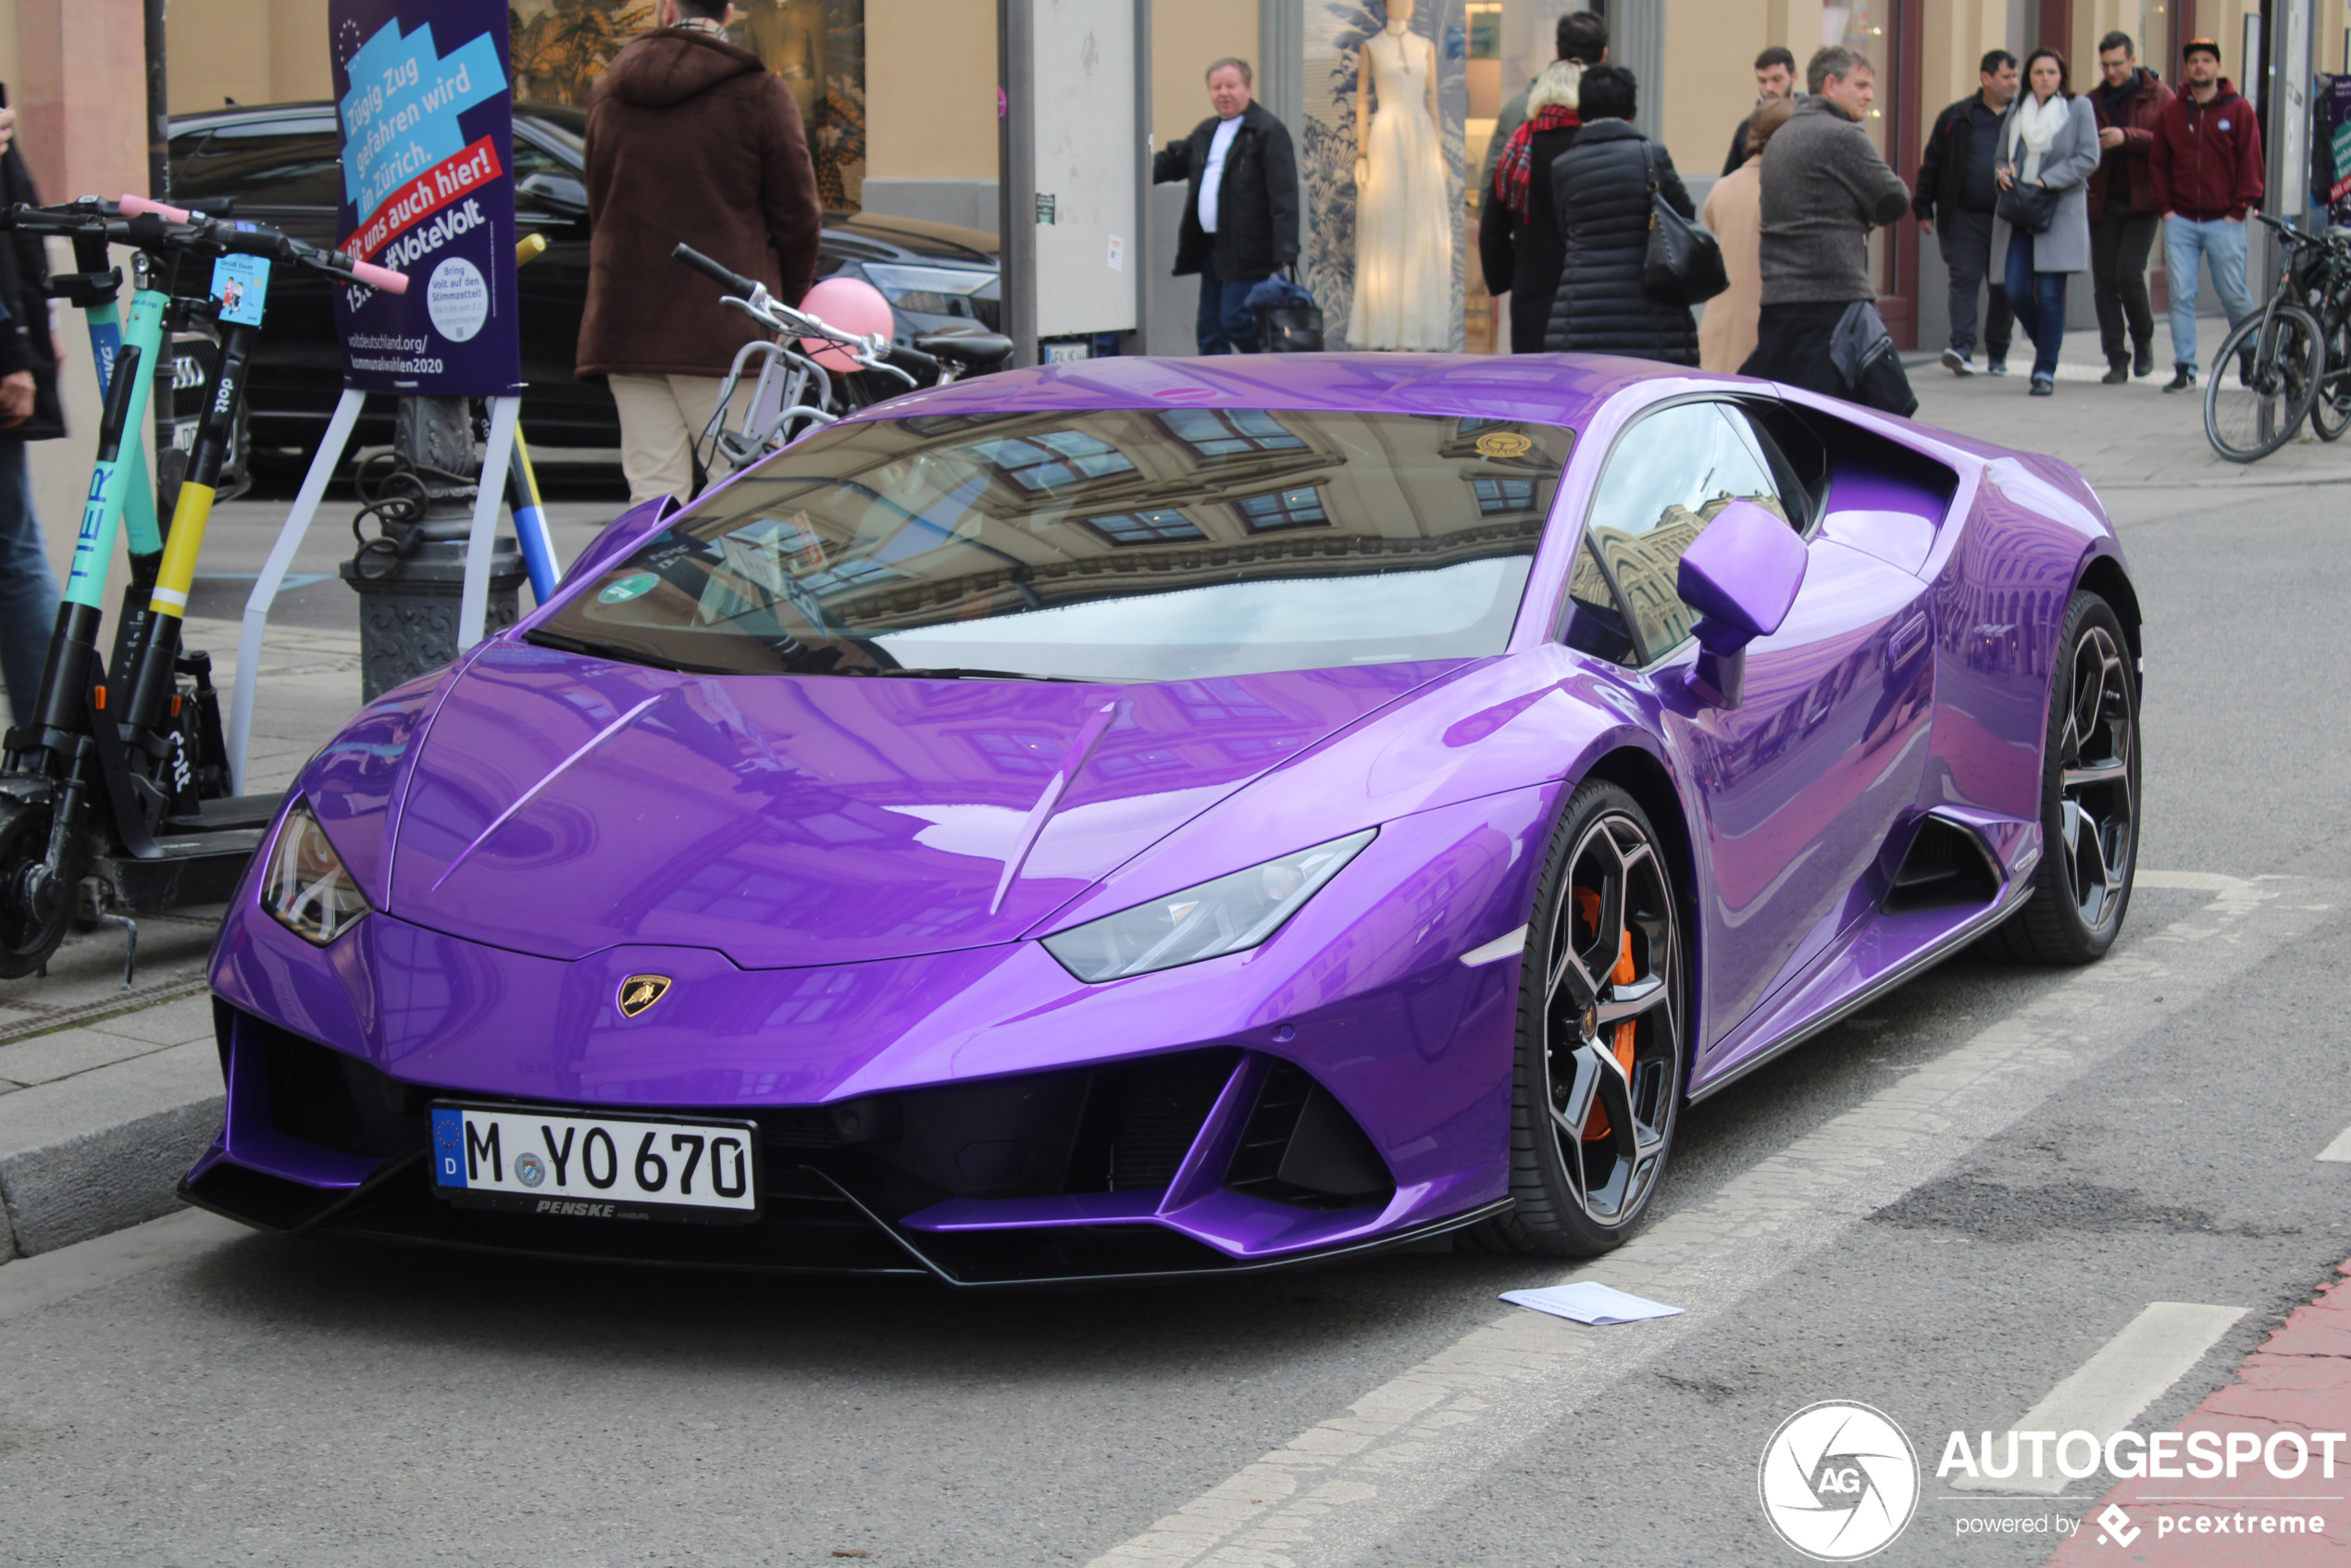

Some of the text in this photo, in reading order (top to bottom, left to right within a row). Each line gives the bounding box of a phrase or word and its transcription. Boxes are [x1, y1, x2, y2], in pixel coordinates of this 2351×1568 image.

[347, 57, 419, 136] Zügig Zug
[356, 62, 472, 180] gefahren wird
[361, 140, 432, 214] in Zürich.
[364, 217, 388, 253] uns
[388, 180, 435, 230] auch
[434, 146, 491, 199] hier!
[385, 197, 485, 272] #VoteVolt
[431, 277, 479, 289] Volt auf den
[443, 266, 465, 277] Bring
[431, 288, 482, 303] Stimmzettel!
[347, 332, 429, 355] voltdeutschland.org/
[350, 353, 444, 374] kommunalwahlen2020
[214, 378, 234, 414] dott
[66, 467, 114, 592] TIER
[445, 1157, 457, 1175] D
[465, 1120, 504, 1183] M
[541, 1125, 618, 1189] YO
[634, 1131, 747, 1199] 670
[535, 1200, 616, 1218] PENSKE
